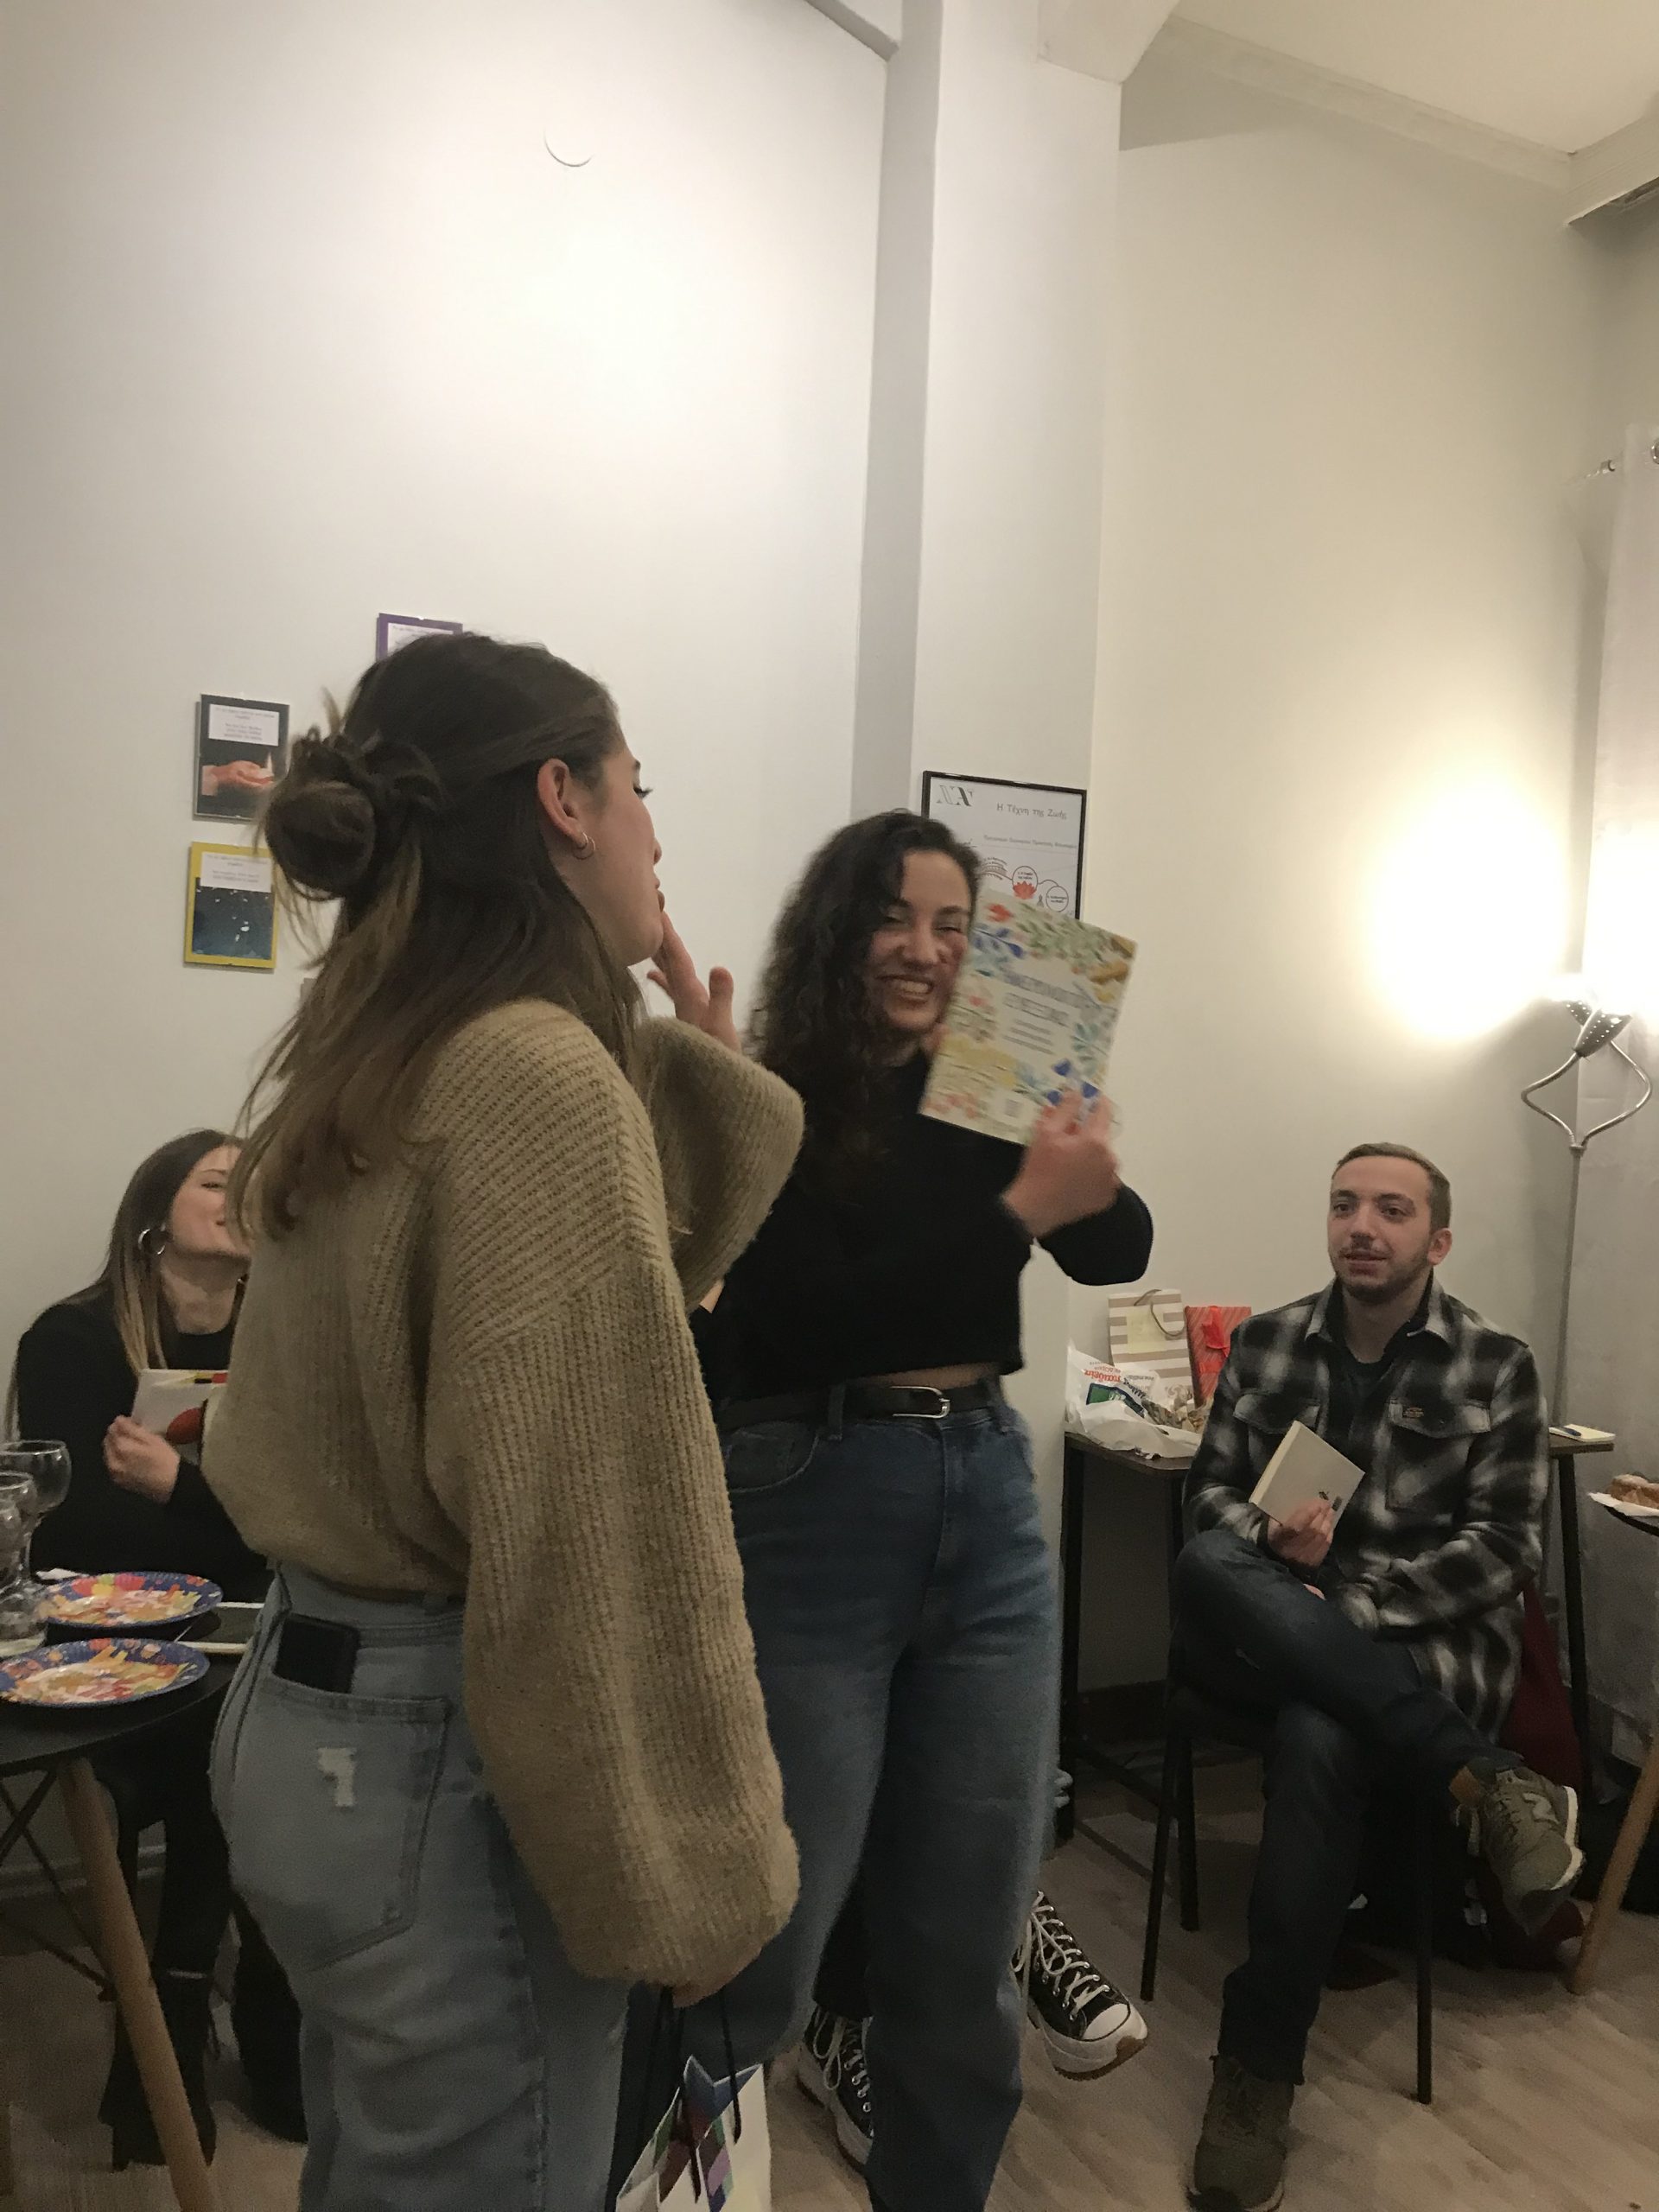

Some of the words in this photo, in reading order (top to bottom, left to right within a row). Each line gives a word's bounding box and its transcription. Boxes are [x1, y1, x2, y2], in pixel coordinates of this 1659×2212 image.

[996, 803, 1004, 811] Η
[1007, 804, 1030, 816] Τέχνη
[1033, 809, 1045, 817] της
[1047, 808, 1067, 820] Ζωής
